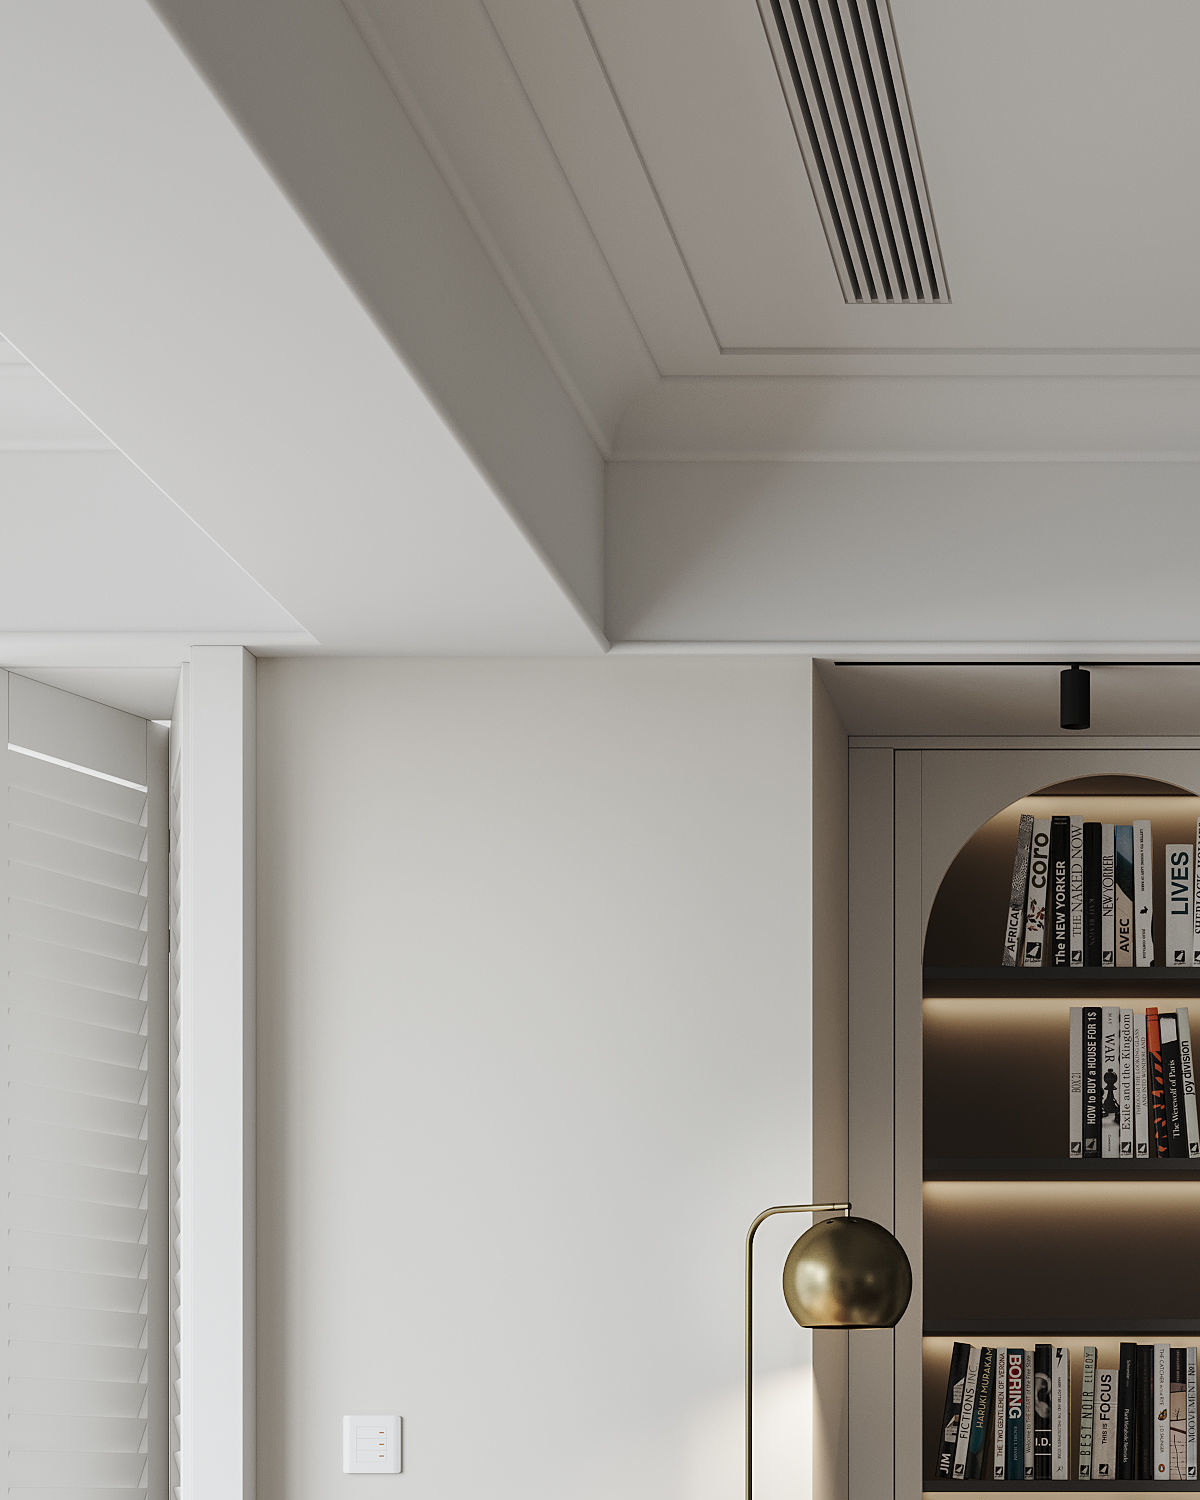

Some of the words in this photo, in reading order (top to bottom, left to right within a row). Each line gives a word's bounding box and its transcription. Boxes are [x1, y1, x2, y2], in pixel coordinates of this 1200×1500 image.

[1072, 824, 1082, 859] NOW
[1056, 861, 1066, 910] YORKER
[1072, 863, 1082, 912] NAKED
[1171, 851, 1189, 915] LIVES
[1056, 912, 1066, 940] NEW
[1072, 915, 1081, 937] THE
[1120, 919, 1129, 952] AVEC
[1055, 943, 1066, 965] The
[1104, 1034, 1115, 1063] WAR
[1122, 1014, 1132, 1060] Kingdom
[1122, 1062, 1131, 1079] the
[1122, 1081, 1130, 1101] and
[1122, 1103, 1130, 1130] Exile
[1008, 1354, 1022, 1420] BORING
[940, 1452, 951, 1475] JIM
